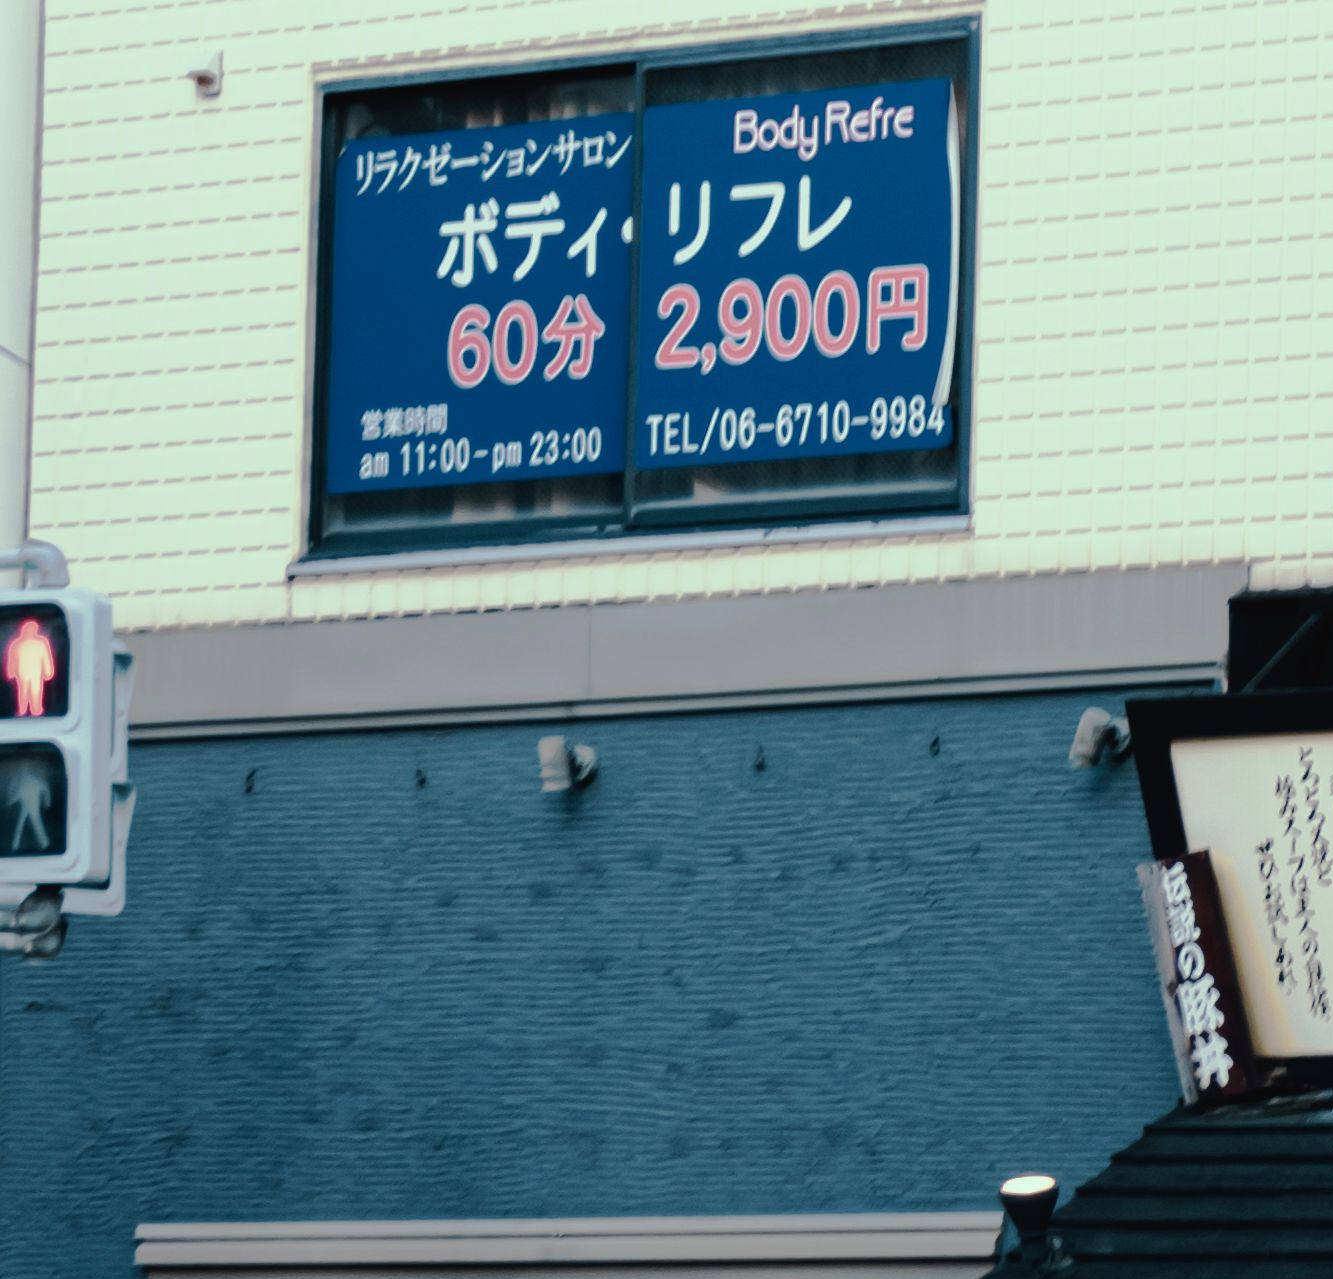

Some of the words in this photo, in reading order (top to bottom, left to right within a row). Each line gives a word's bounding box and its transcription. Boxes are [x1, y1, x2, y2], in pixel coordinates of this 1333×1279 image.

[733, 104, 818, 160] Body
[824, 97, 914, 145] Refre
[356, 129, 632, 196] リラクゼーションサロン
[668, 174, 852, 265] リフレ
[447, 293, 605, 389] 60分
[653, 262, 930, 375] 2,900円
[359, 451, 390, 480] am
[529, 426, 602, 467] 23:00
[360, 403, 448, 441] 営業時間
[646, 393, 946, 456] TEL/06-6710-9984
